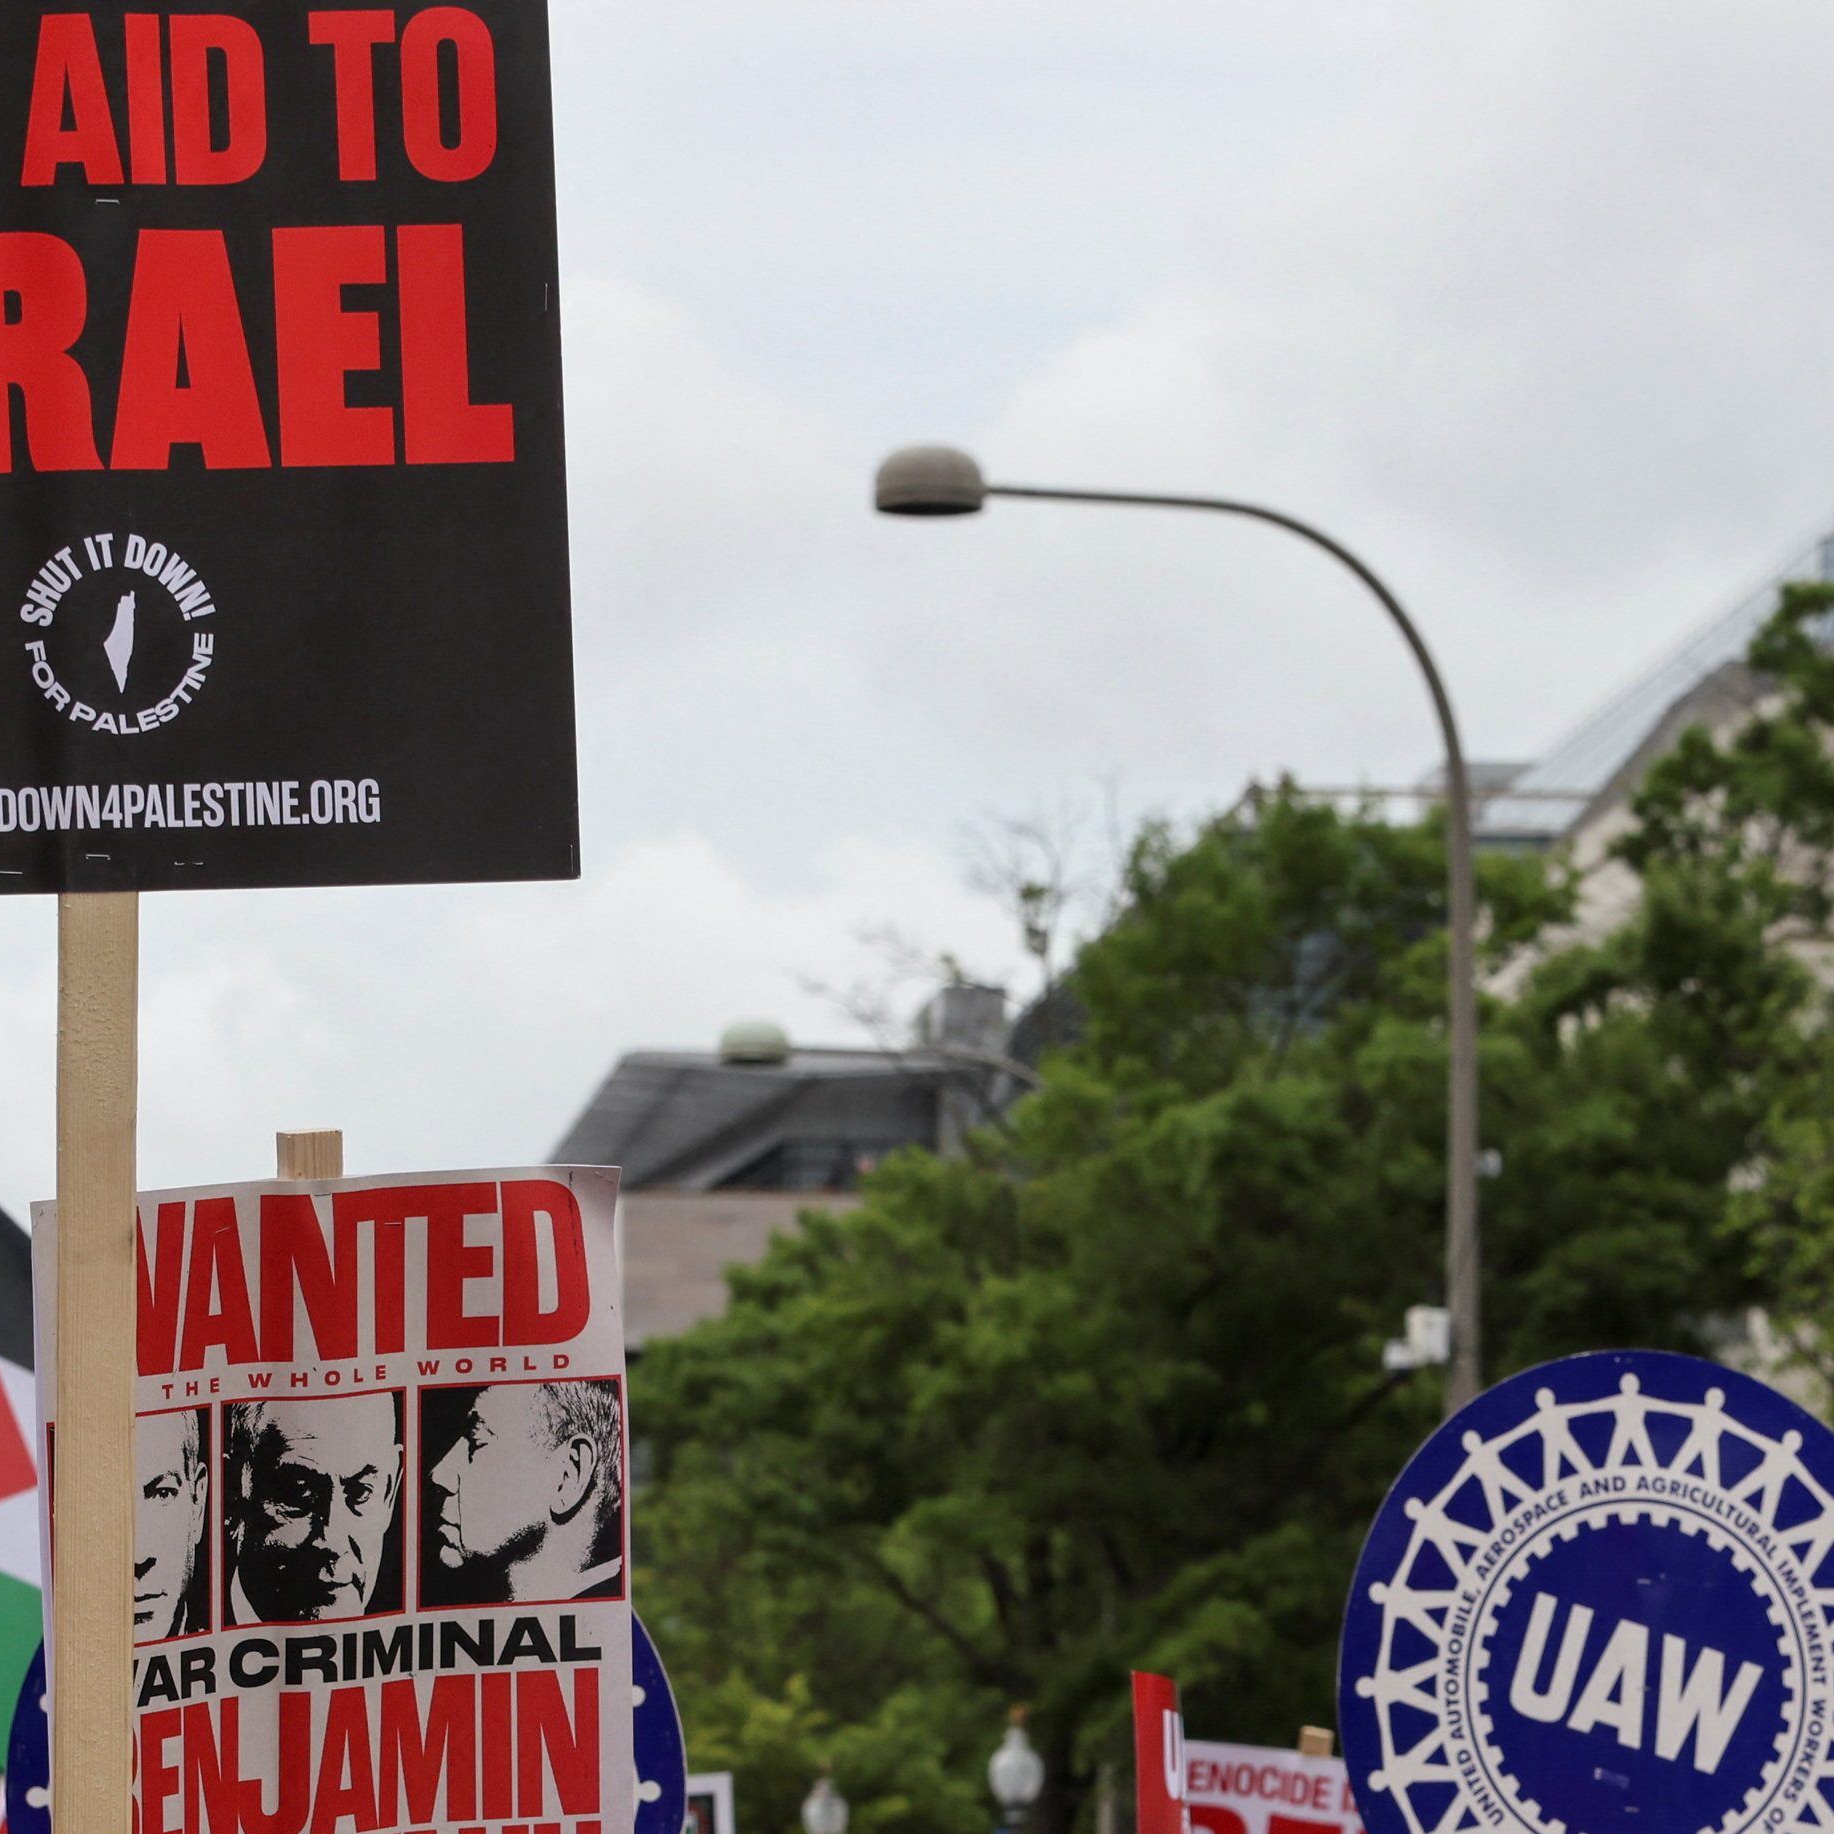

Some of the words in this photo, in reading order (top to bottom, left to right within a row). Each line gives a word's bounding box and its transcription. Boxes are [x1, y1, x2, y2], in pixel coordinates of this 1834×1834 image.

[21, 12, 267, 187] AID
[308, 6, 498, 182] TO
[20, 546, 83, 627] SHUT
[83, 533, 114, 571] IT
[124, 533, 216, 621] DOWN!
[25, 640, 71, 712] FOR
[69, 632, 214, 735] PALESTINE
[162, 1377, 220, 1400] THE
[248, 1365, 387, 1388] WHOLE
[417, 1354, 571, 1376] WORLD
[1579, 1476, 1627, 1498] AND
[1637, 1477, 1775, 1560] AGRICULTURAL
[1476, 1490, 1568, 1580] AEROSPACE
[133, 1647, 216, 1707] AR
[229, 1615, 602, 1689] CRIMINAL
[1446, 1588, 1481, 1739] AUTOMOBILE,
[1777, 1561, 1827, 1686] IMPLEMENT
[1509, 1592, 1764, 1775] UAW
[1187, 1759, 1330, 1811] ENOCIDE
[1457, 1749, 1505, 1826] UNITED
[1784, 1701, 1826, 1803] WORKERS
[1764, 1808, 1785, 1834] OF
